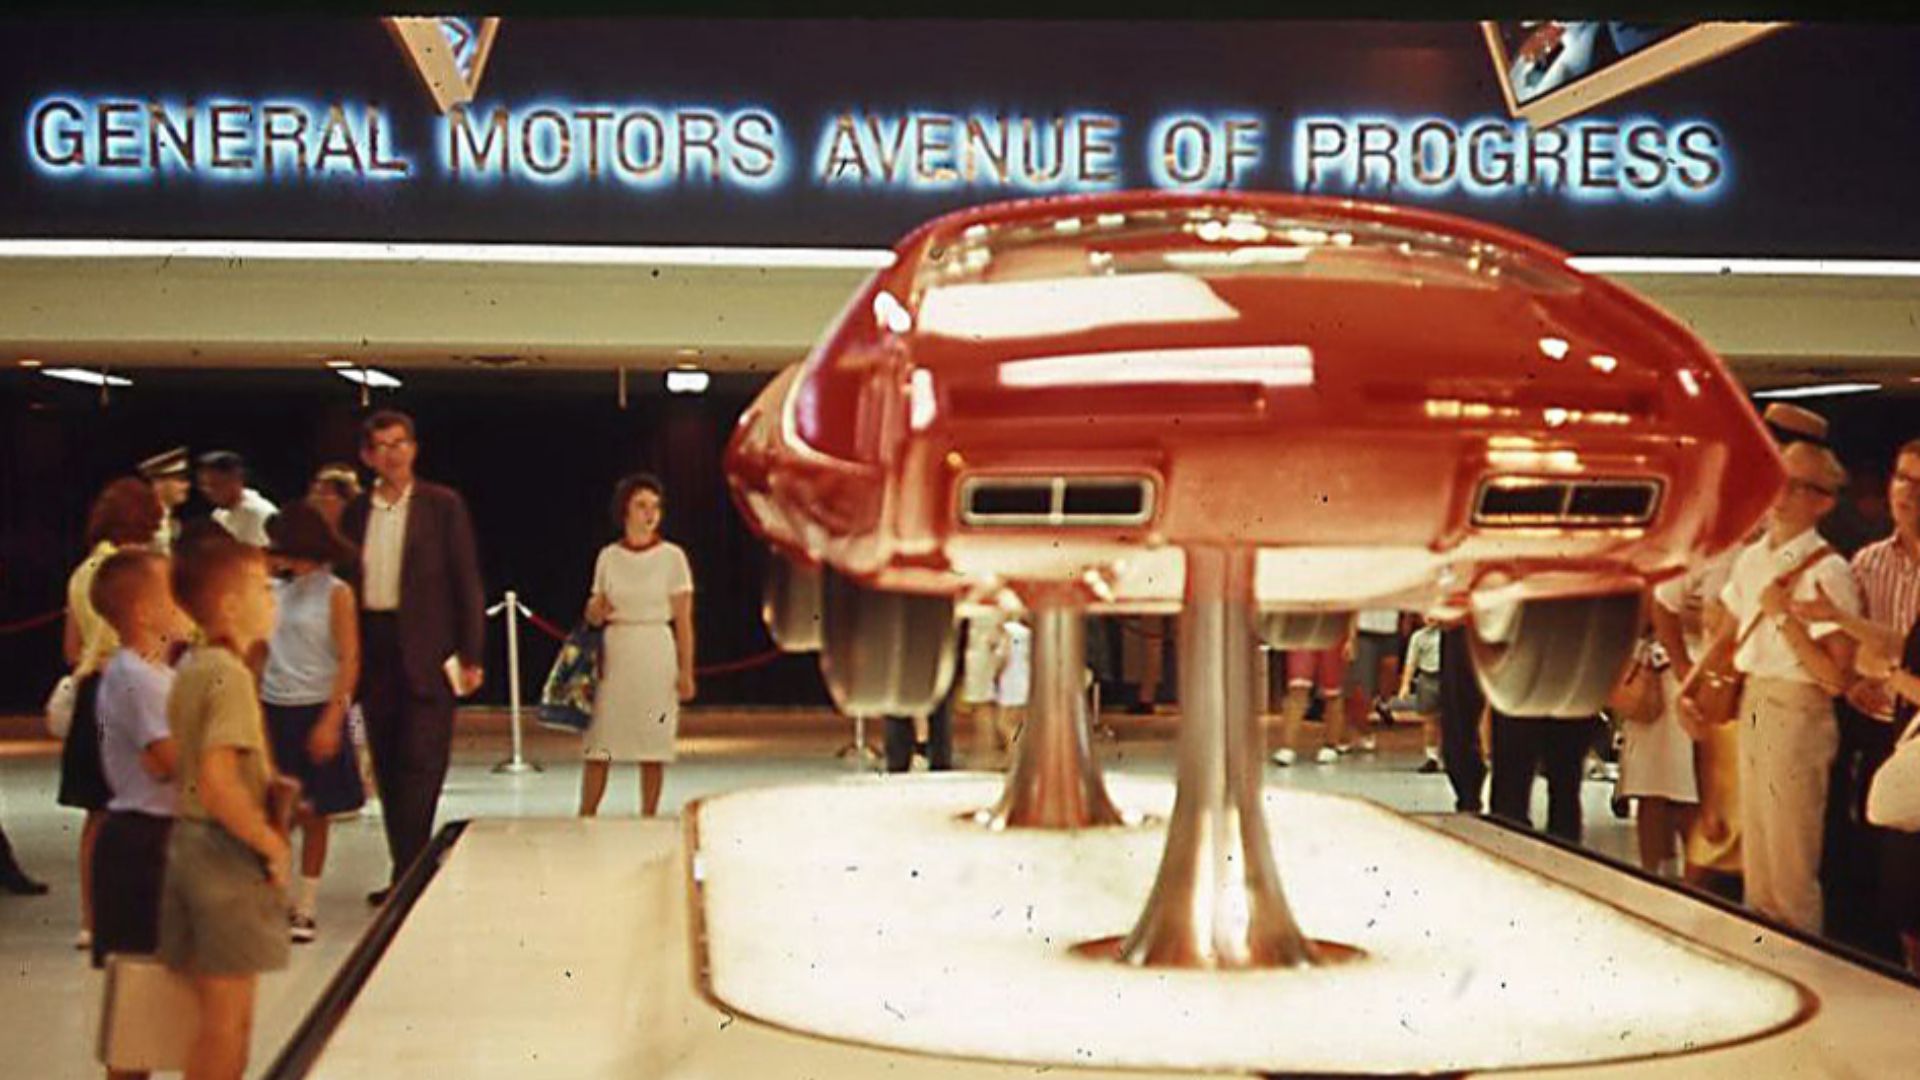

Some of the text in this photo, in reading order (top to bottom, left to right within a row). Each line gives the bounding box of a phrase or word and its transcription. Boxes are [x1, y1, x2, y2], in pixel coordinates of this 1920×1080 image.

[33, 100, 1721, 189] GENERAL MOTORS AVENUE OF PROGRESS
